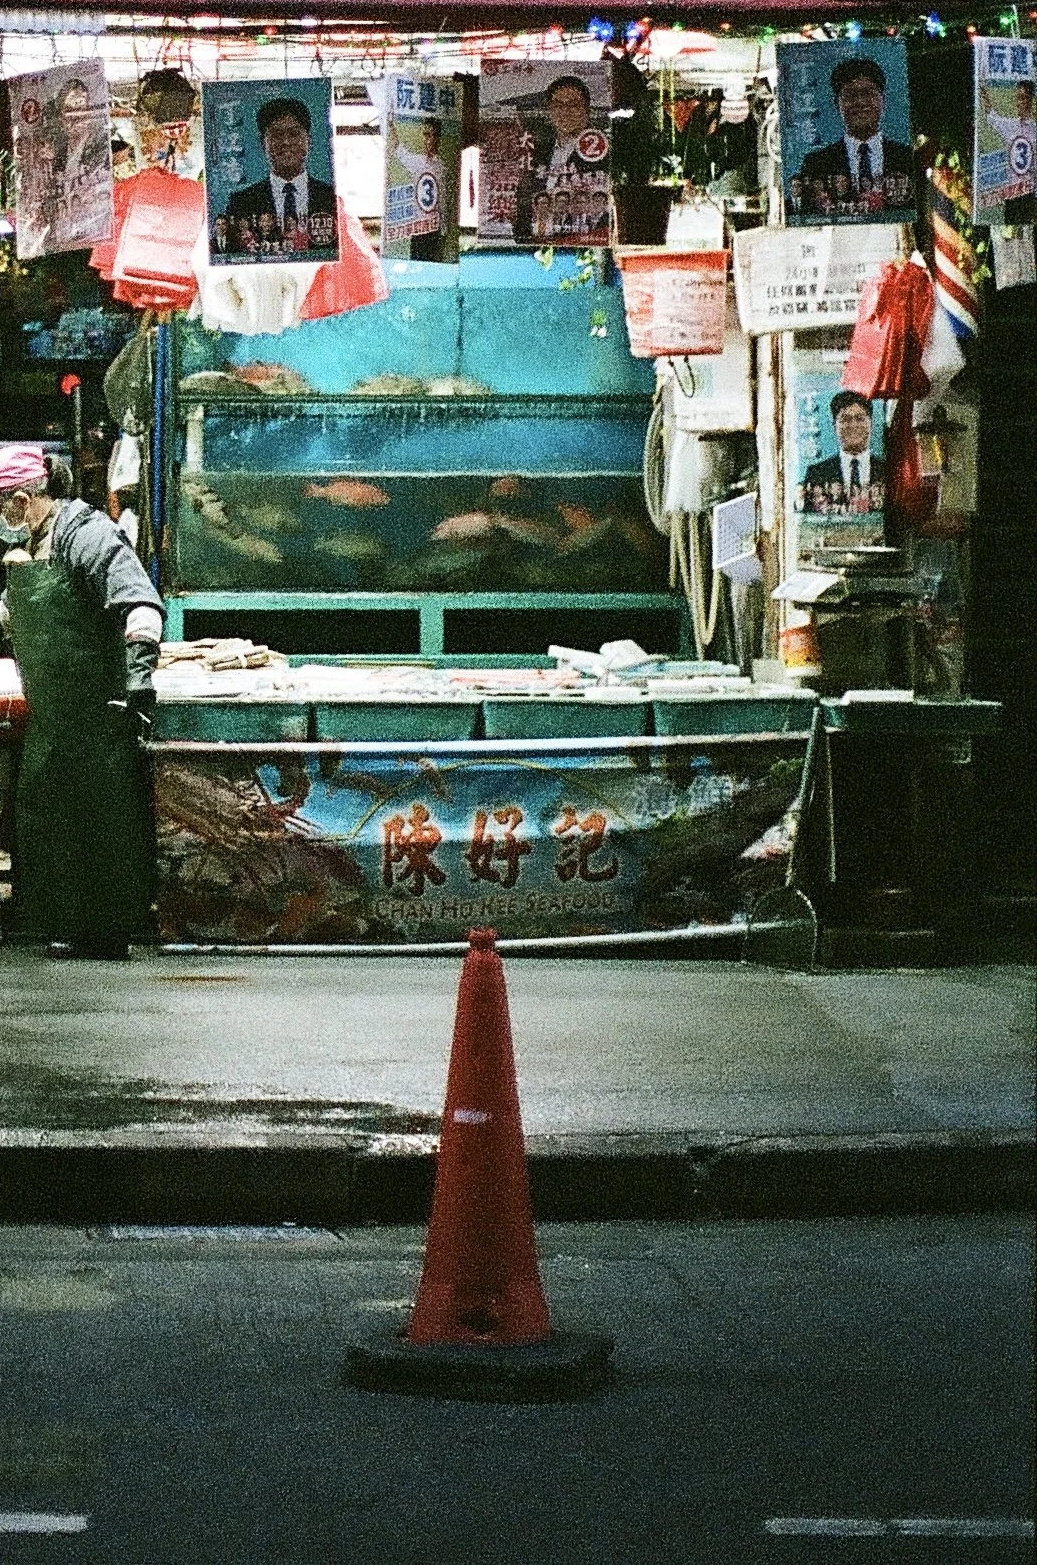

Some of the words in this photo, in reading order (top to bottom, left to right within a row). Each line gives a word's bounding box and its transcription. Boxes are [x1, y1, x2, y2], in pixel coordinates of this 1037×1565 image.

[988, 44, 1037, 74] 阮建
[585, 136, 601, 155] 2
[1015, 143, 1028, 169] 3
[421, 179, 434, 206] 3
[380, 803, 620, 898] 陳好記
[374, 898, 432, 919] CHAN
[440, 898, 473, 919] HO
[480, 896, 516, 916] KEE
[526, 893, 614, 912] SEAFOOD
